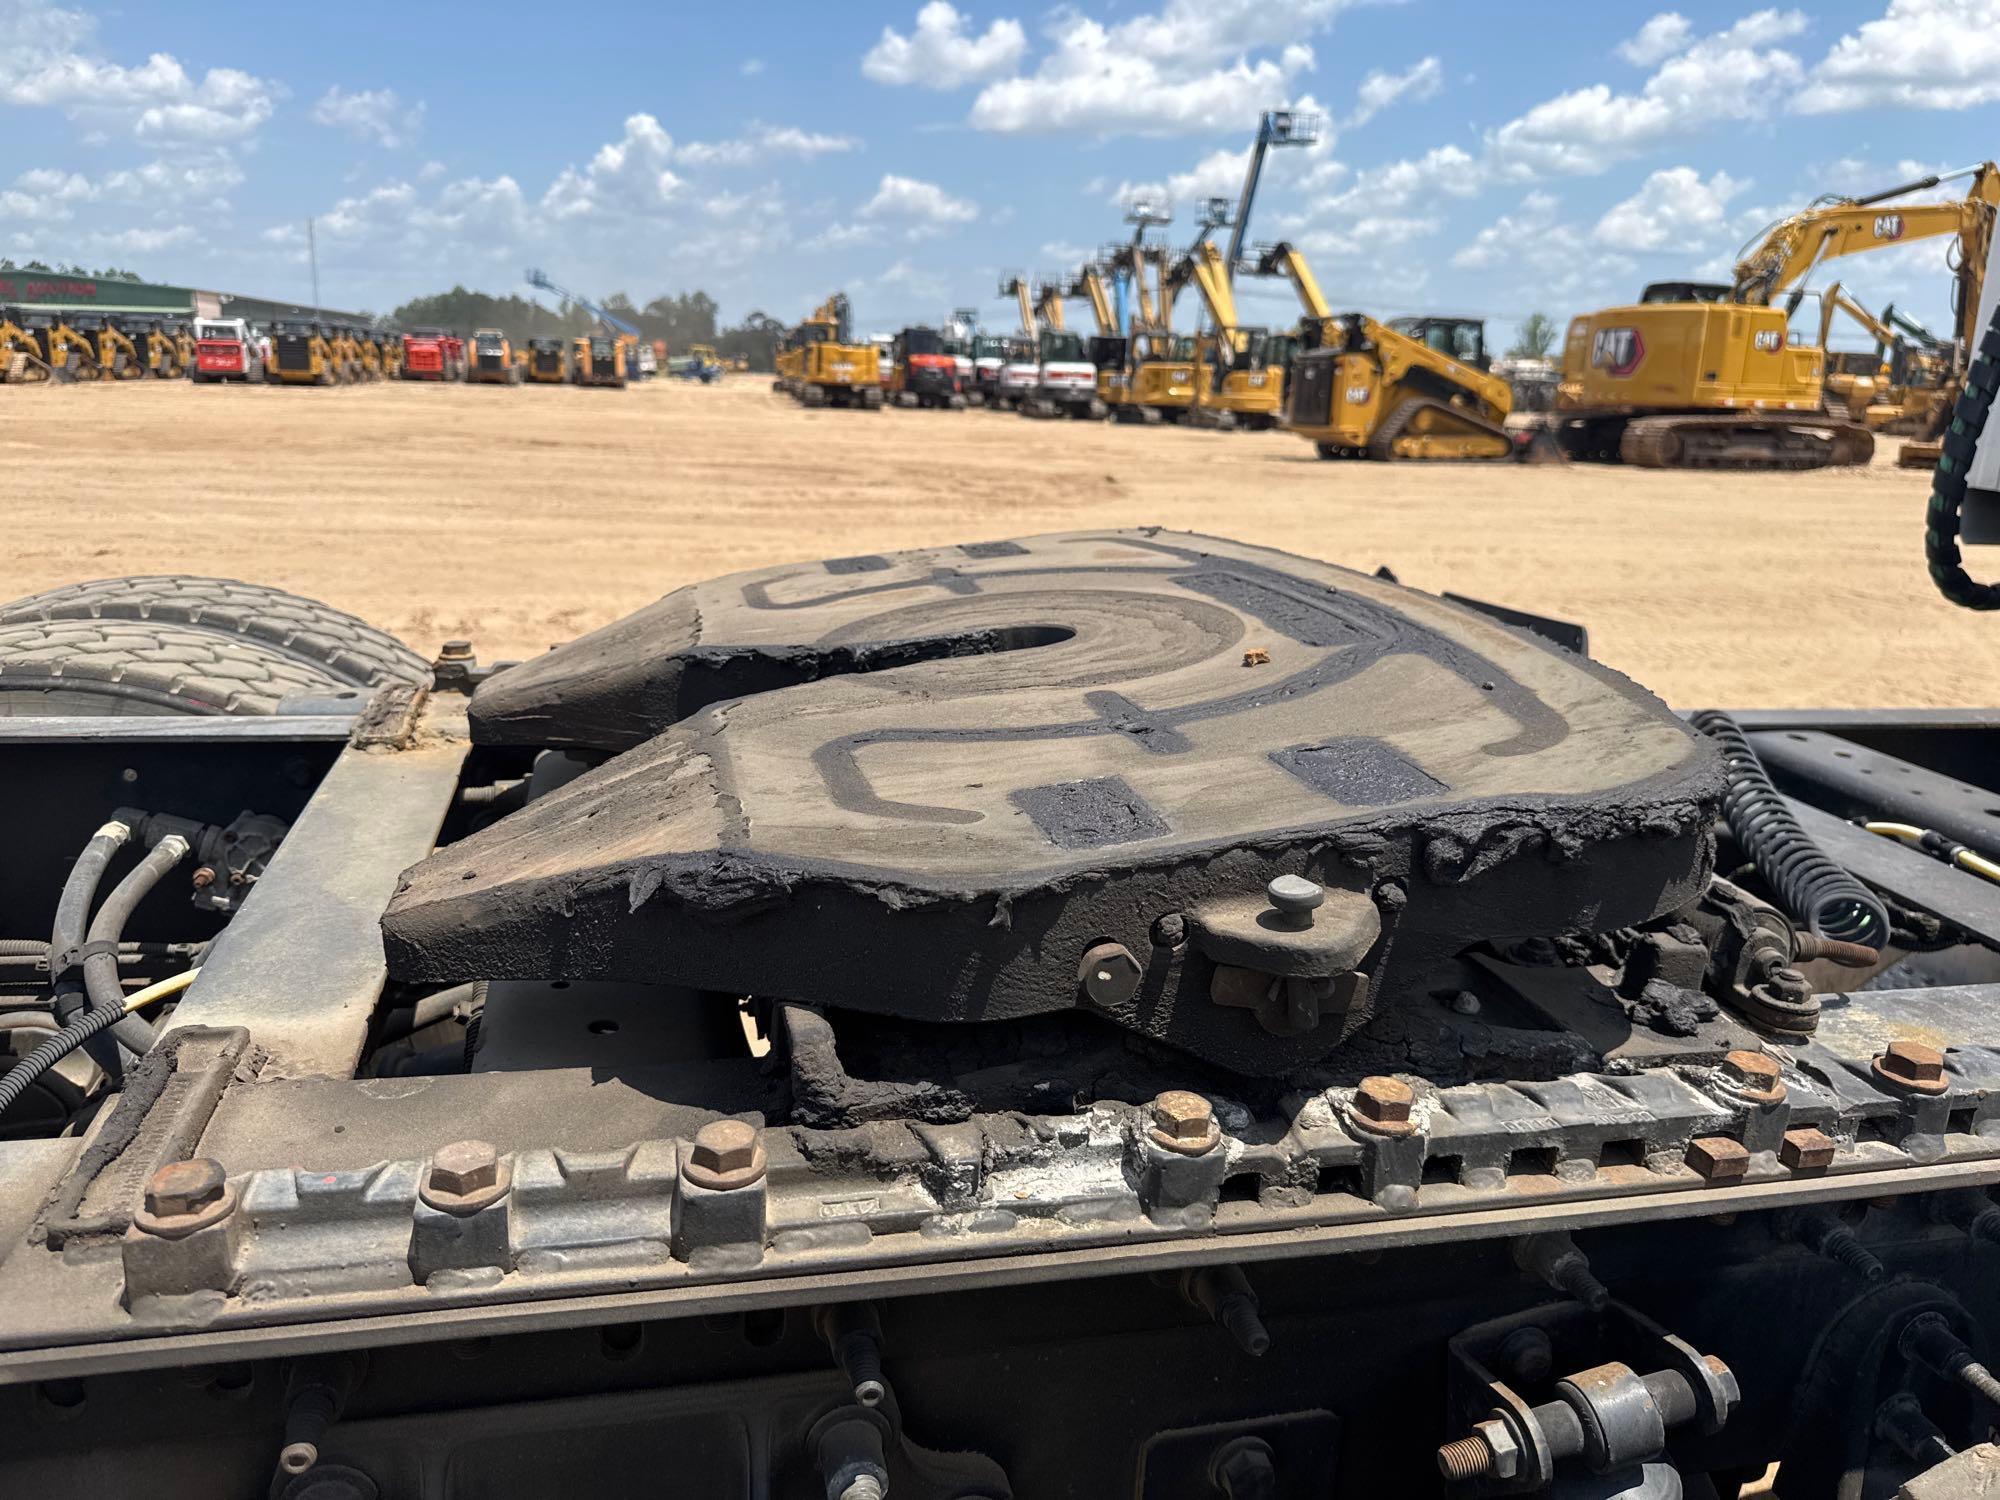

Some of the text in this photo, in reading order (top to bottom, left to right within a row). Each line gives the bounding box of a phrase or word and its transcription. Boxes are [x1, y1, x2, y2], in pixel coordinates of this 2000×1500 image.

[1873, 215, 1900, 239] CAT
[1591, 328, 1634, 369] CAT
[1754, 330, 1779, 350] CAT
[1345, 386, 1369, 403] CAT
